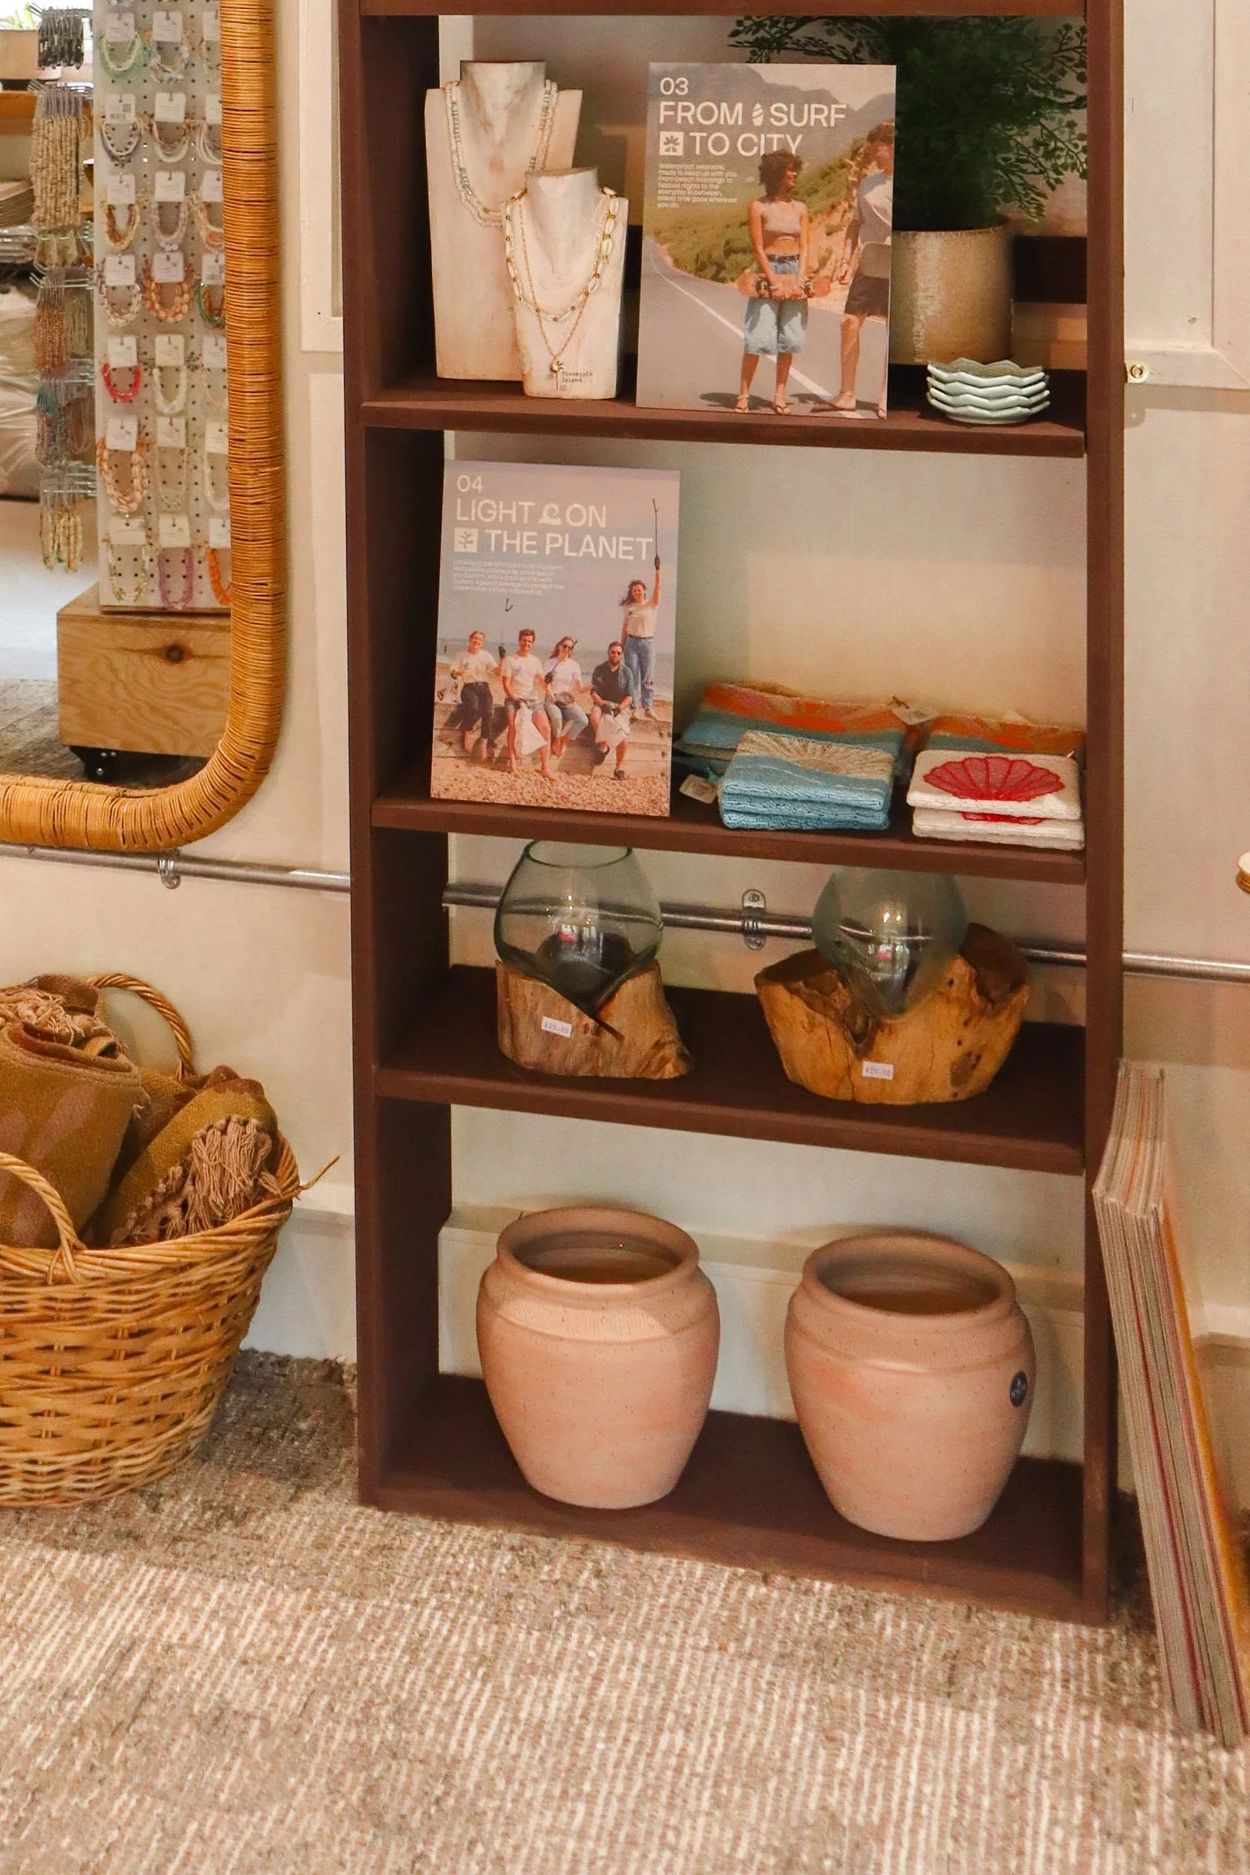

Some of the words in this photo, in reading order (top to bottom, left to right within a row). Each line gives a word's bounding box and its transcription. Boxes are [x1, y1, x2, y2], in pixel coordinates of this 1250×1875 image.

[660, 77, 689, 95] 03
[660, 101, 743, 125] FROM
[770, 103, 847, 127] SURF
[690, 132, 730, 156] TO
[737, 133, 803, 156] CITY
[457, 475, 483, 493] 04
[456, 499, 535, 524] LIGHT
[566, 503, 606, 528] ON
[485, 529, 538, 554] THE
[545, 533, 653, 561] PLANET
